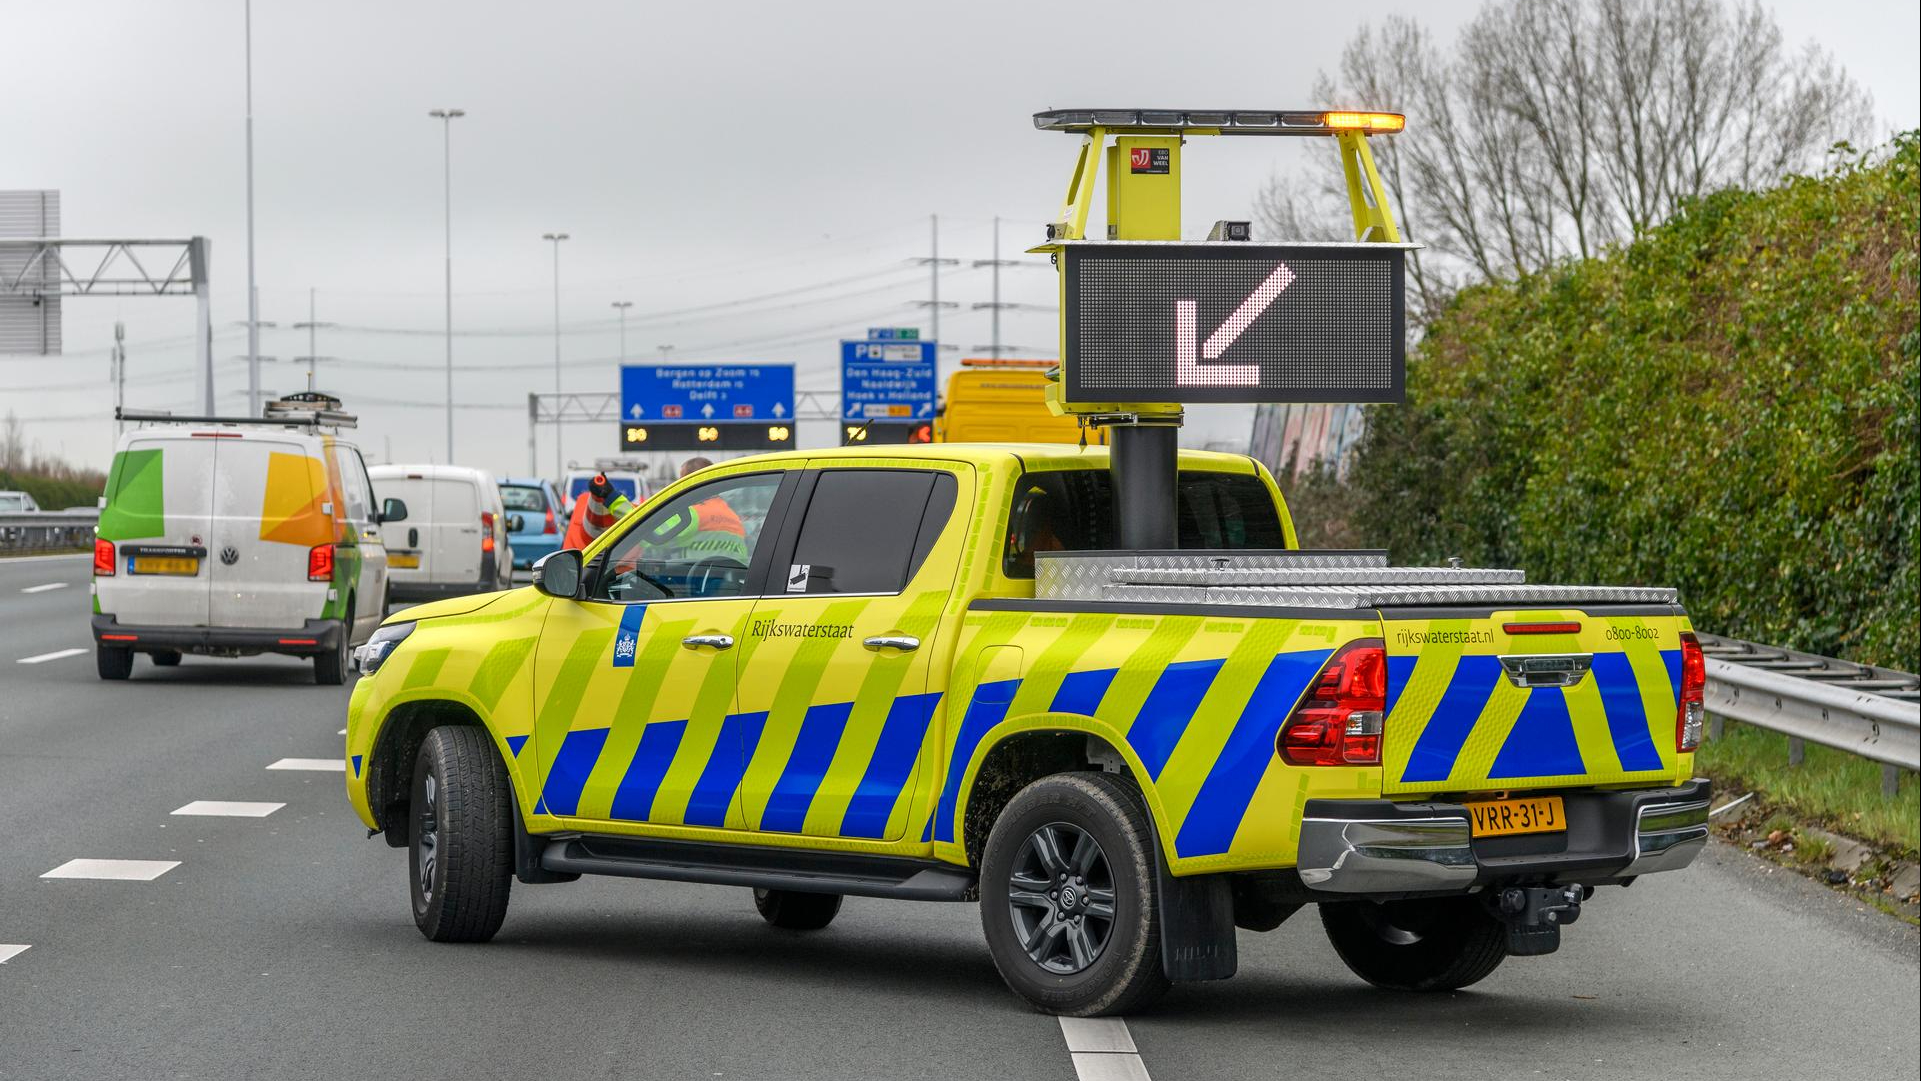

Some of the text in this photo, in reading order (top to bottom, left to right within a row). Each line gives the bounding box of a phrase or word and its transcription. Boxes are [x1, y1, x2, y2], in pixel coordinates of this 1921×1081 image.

[656, 368, 695, 379] Bergen
[698, 369, 712, 379] op
[715, 368, 746, 377] Zoom
[846, 368, 932, 379] Den Haag-Zuid
[672, 379, 732, 389] Rotterdam
[861, 380, 917, 391] Naaldwijk
[689, 390, 718, 400] Delft
[847, 391, 875, 400] Hoek
[888, 391, 931, 400] Holland
[751, 619, 854, 642] Rijkswaterstaat
[1605, 625, 1660, 641] 0800-8002
[1397, 628, 1495, 648] rijkswaterstaat.nl
[1473, 802, 1554, 831] VRR-31-J
